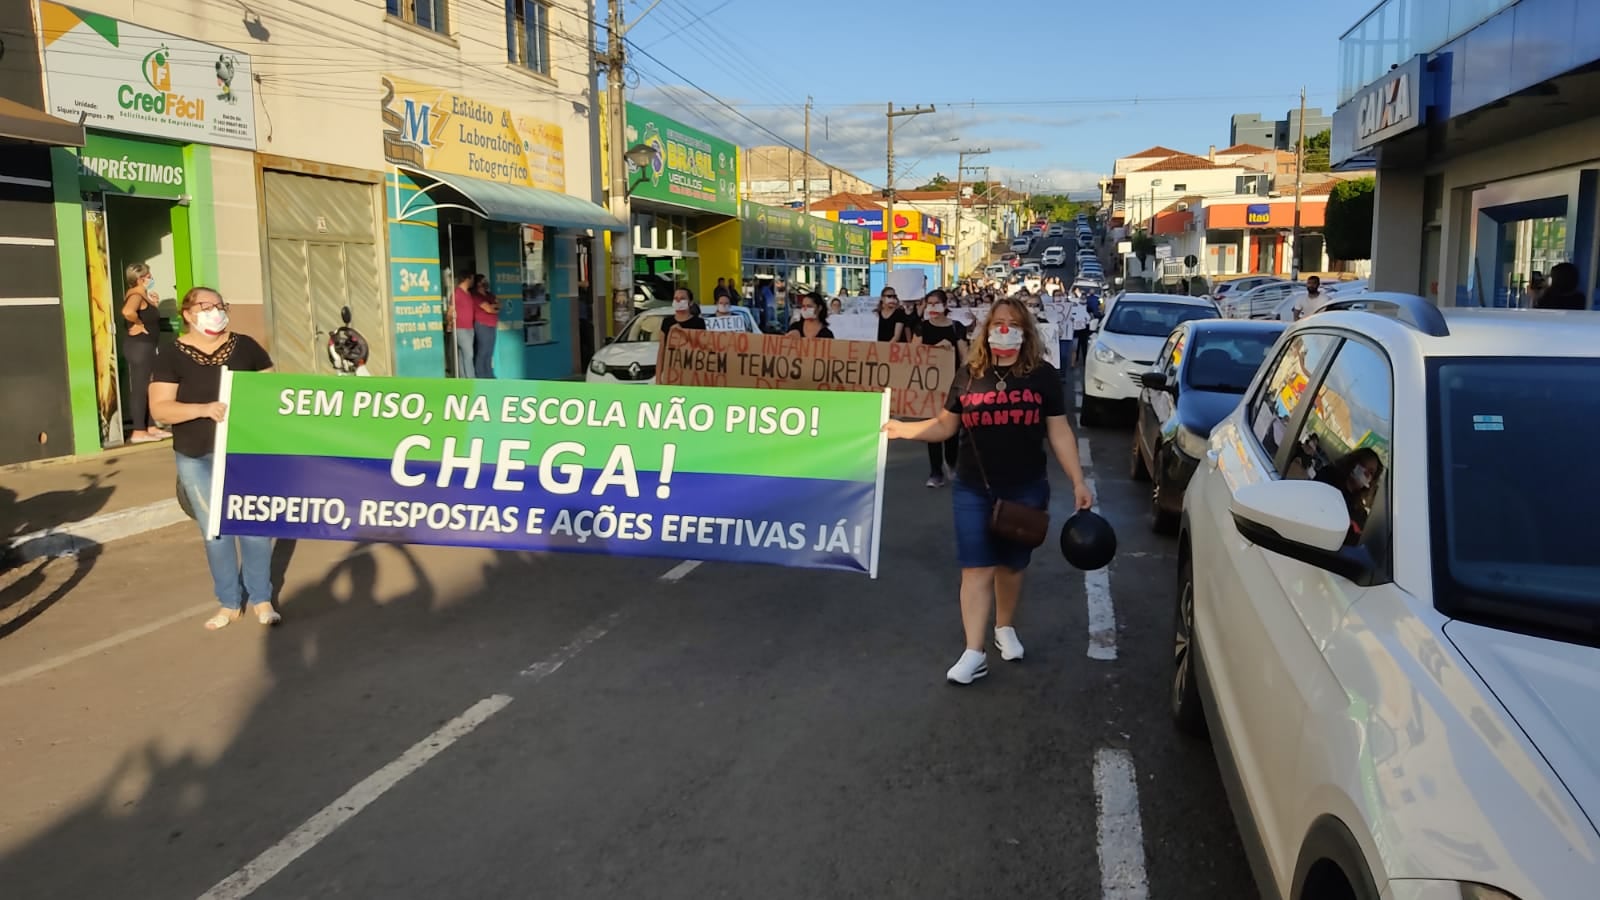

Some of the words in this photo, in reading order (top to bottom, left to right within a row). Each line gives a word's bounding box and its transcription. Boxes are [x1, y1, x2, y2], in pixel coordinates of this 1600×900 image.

[118, 84, 205, 121] CredFácil
[452, 96, 494, 125] Estúdio
[501, 111, 509, 128] &
[1358, 74, 1410, 138] CAIXA
[459, 124, 522, 156] Laboratório
[468, 152, 528, 183] Fotográfico
[667, 140, 716, 181] BRASIL
[400, 268, 430, 292] 3x4
[761, 334, 837, 359] INFANTIL
[866, 342, 879, 361] A
[889, 343, 938, 366] BASE
[737, 353, 803, 380] TEMOS
[812, 358, 890, 388] DIREITO
[907, 365, 940, 391] AO
[278, 388, 343, 417] SEM
[352, 391, 433, 424] PISO,
[443, 394, 490, 421] NA
[501, 396, 626, 428] ESCOLA
[637, 397, 714, 432] NÃO
[725, 405, 820, 437] PISO!
[227, 494, 351, 530] RESPEITO,
[359, 499, 519, 533] RESPOSTAS
[526, 507, 545, 534] E
[551, 504, 653, 543] AÇÕES
[661, 514, 806, 550] EFETIVAS
[812, 518, 862, 554] JÁ!
